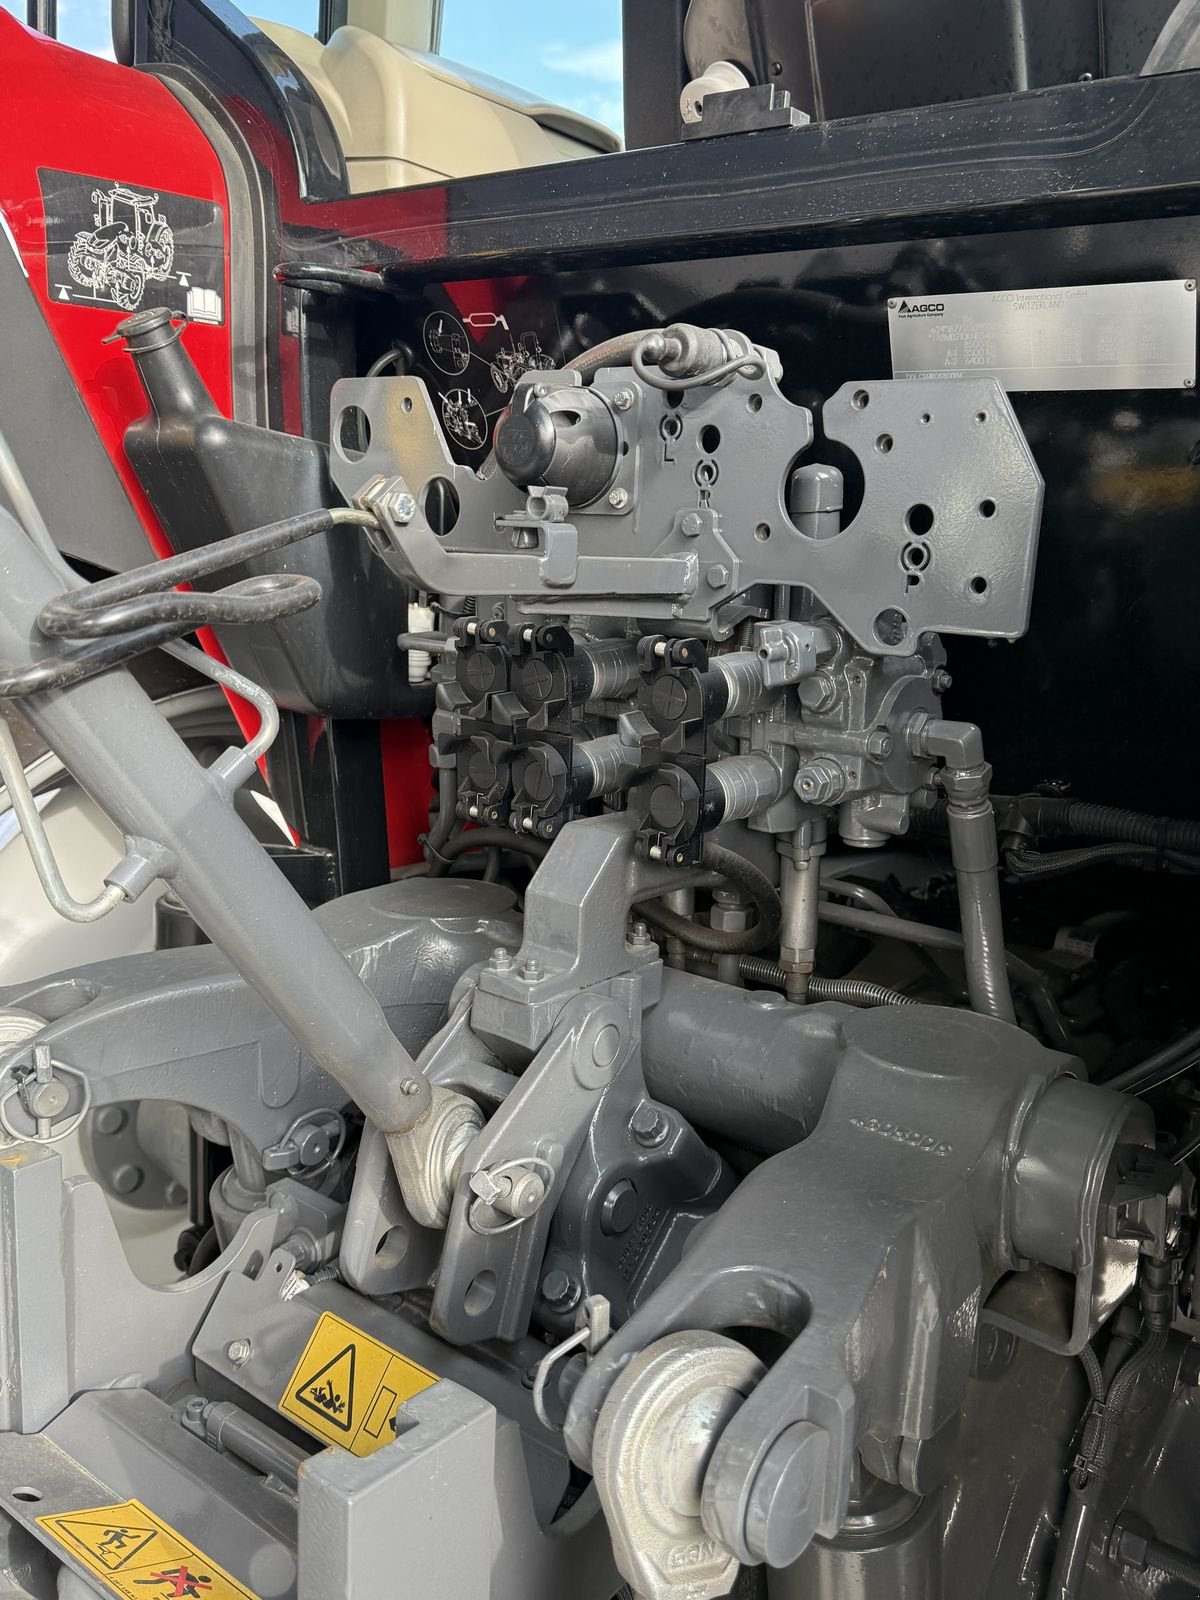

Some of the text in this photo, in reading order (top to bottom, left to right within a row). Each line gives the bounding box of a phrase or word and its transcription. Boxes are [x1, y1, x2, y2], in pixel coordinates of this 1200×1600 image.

[911, 303, 945, 313] AGCO
[1013, 301, 1065, 311] SWITZERLAND
[664, 444, 675, 462] L
[699, 490, 711, 508] R
[905, 575, 920, 594] P
